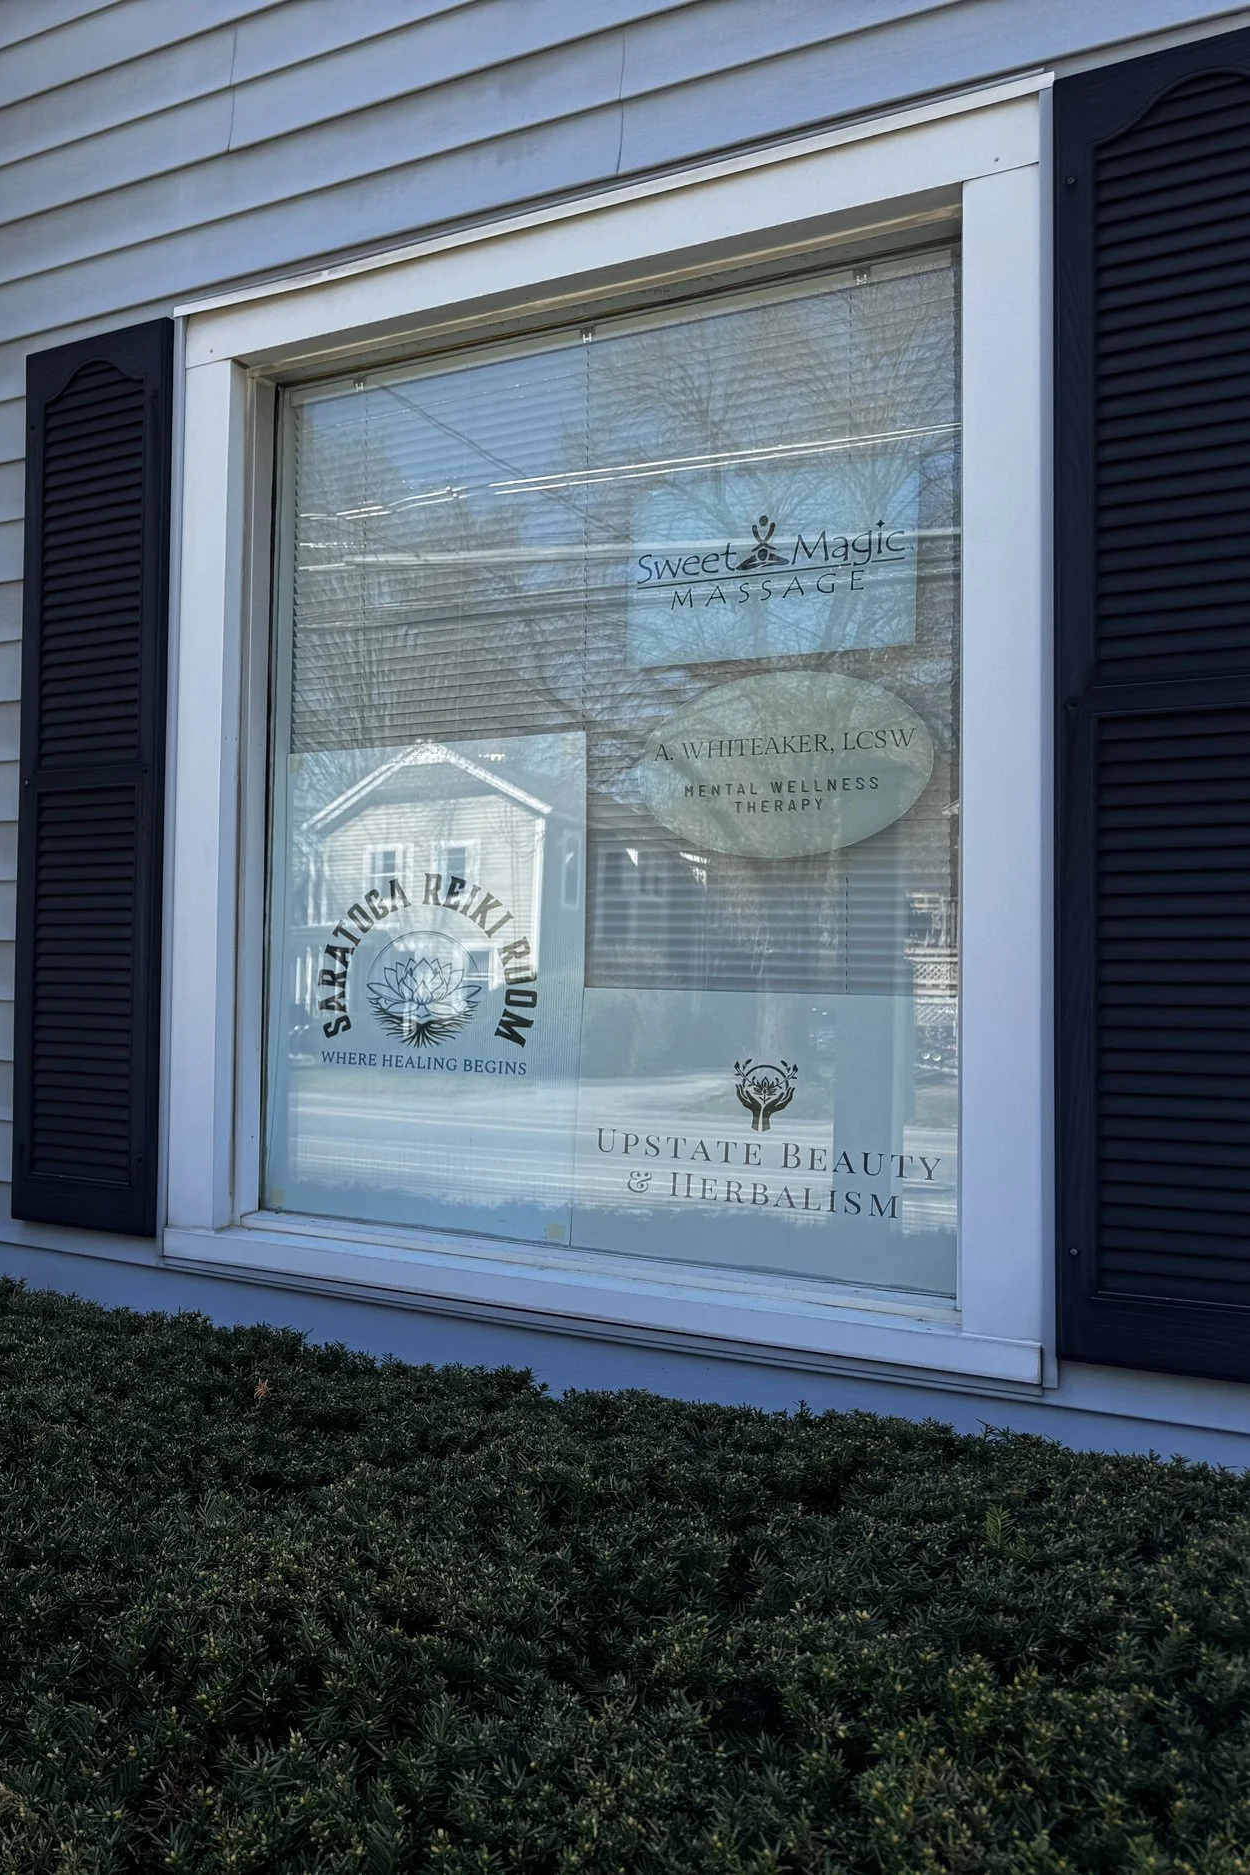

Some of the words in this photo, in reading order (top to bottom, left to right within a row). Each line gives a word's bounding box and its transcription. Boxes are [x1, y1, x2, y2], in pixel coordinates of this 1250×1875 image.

[637, 542, 736, 585] Sweet
[791, 518, 905, 567] Magic
[670, 569, 866, 610] MASSAGE
[653, 745, 674, 762] A.
[681, 733, 834, 760] WHITEAKER,
[842, 728, 916, 750] LCSW
[684, 782, 757, 798] MENTAL
[770, 776, 880, 794] WELLNESS
[734, 797, 825, 814] THERAPY
[318, 878, 412, 1039] SARATOGA
[422, 872, 514, 938] REIKI
[494, 936, 538, 1048] ROOM
[321, 1050, 377, 1067] WHERE
[381, 1054, 458, 1072] HEALING
[463, 1058, 527, 1076] BEGINS
[627, 1170, 652, 1194] &
